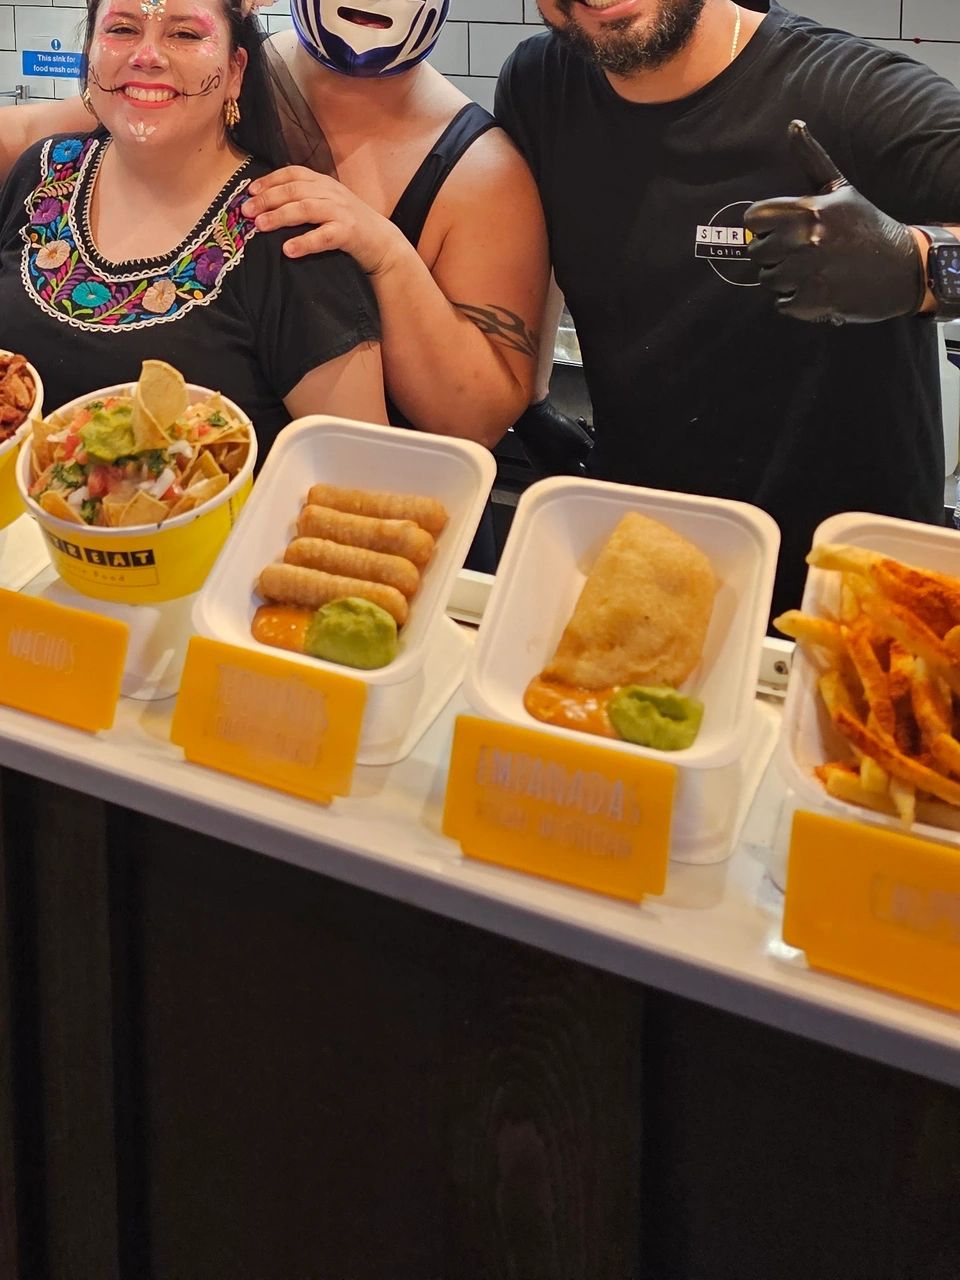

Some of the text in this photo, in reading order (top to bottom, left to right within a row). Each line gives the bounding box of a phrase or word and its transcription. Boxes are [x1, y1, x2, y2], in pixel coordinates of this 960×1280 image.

[37, 54, 76, 63] This sink for
[33, 64, 49, 73] food
[49, 65, 66, 73] wash
[710, 246, 742, 256] Latin
